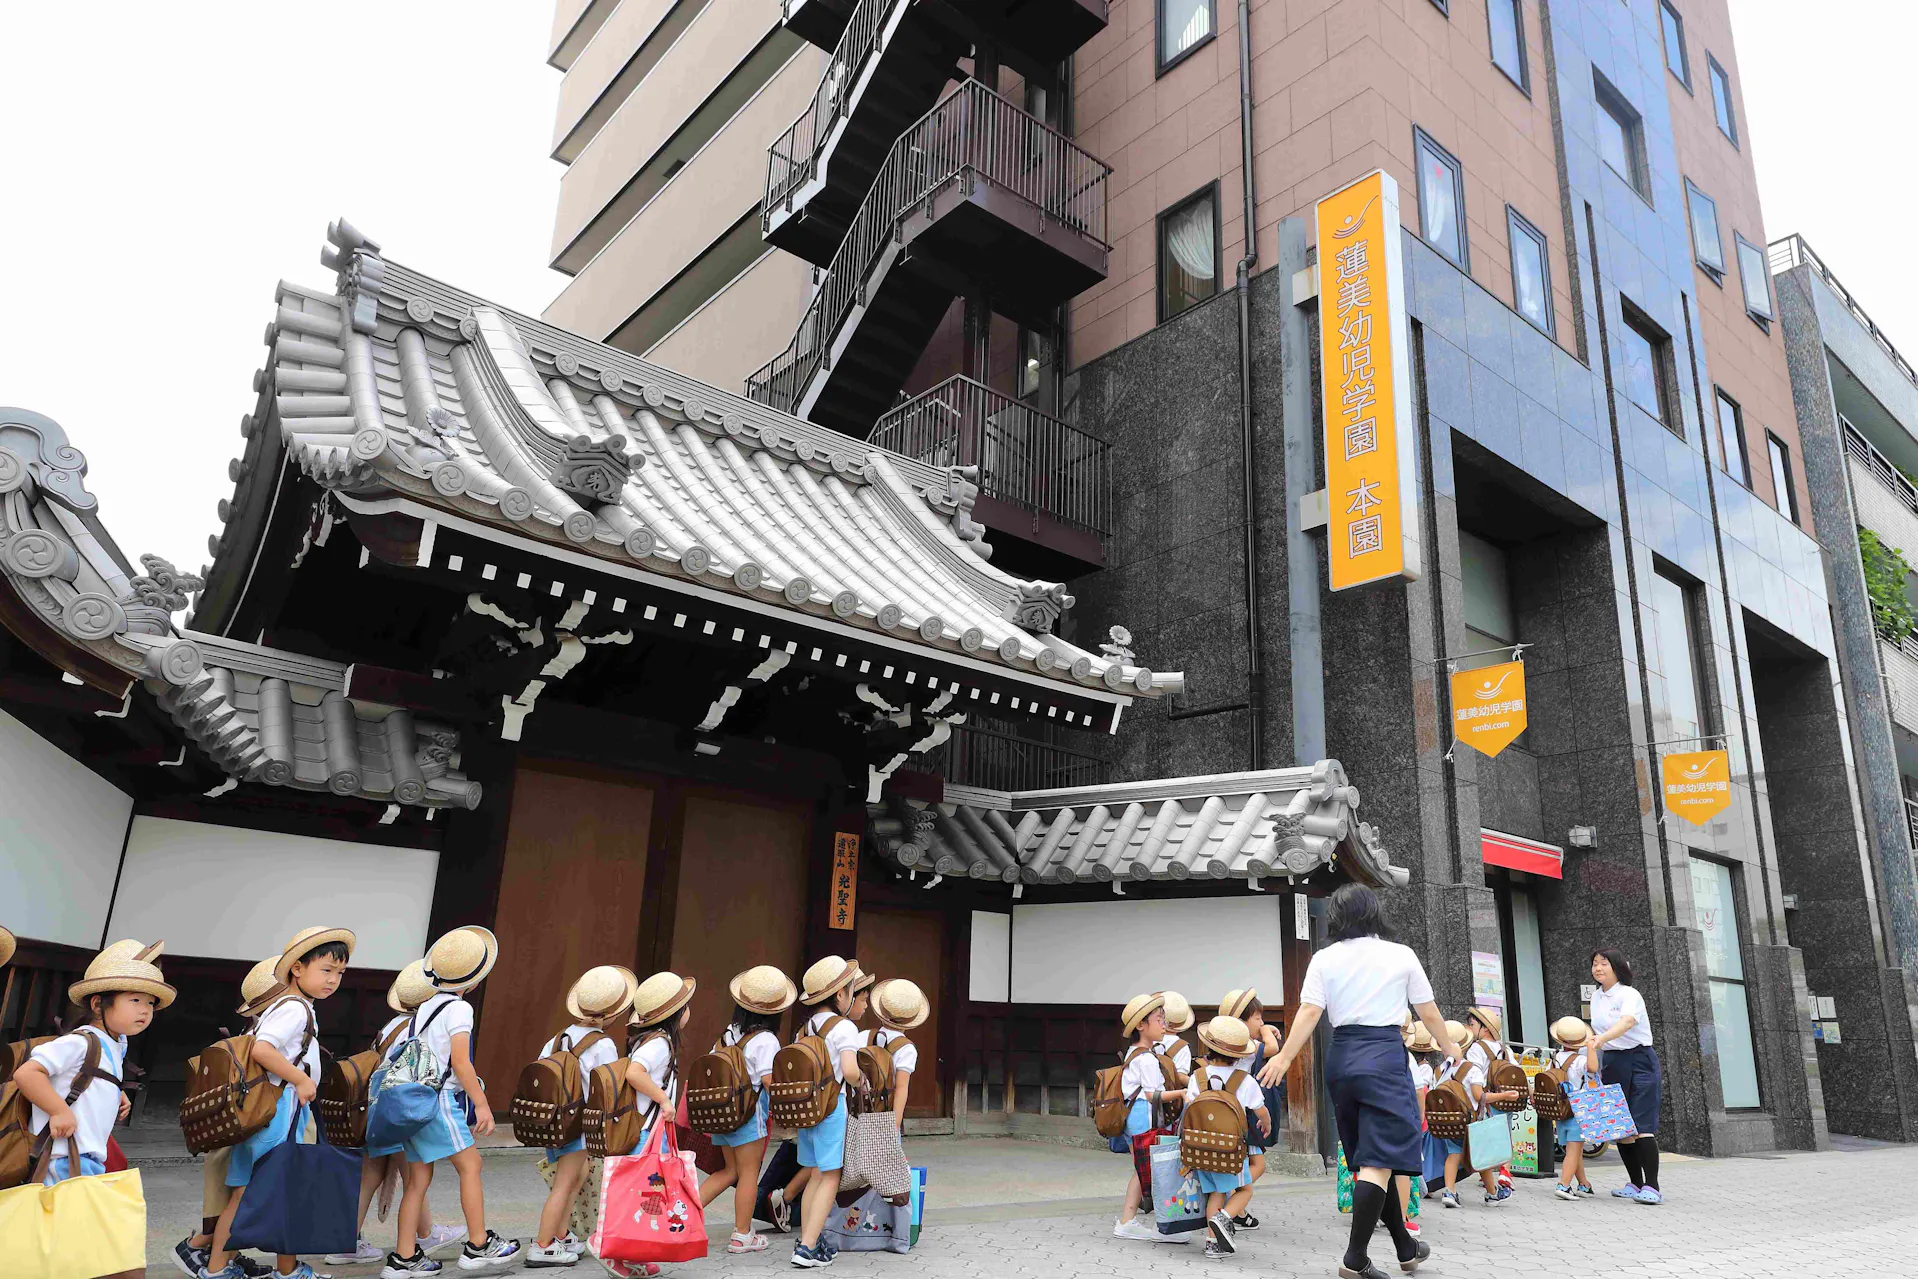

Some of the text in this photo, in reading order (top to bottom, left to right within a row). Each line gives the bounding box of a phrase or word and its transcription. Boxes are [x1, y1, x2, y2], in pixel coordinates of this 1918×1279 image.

[1335, 239, 1384, 559] 蓮美幼児学園 本園
[1456, 699, 1523, 721] 蓮美幼児学園
[1472, 721, 1510, 733] renbi.com
[1667, 781, 1727, 795] 蓮美幼児学園
